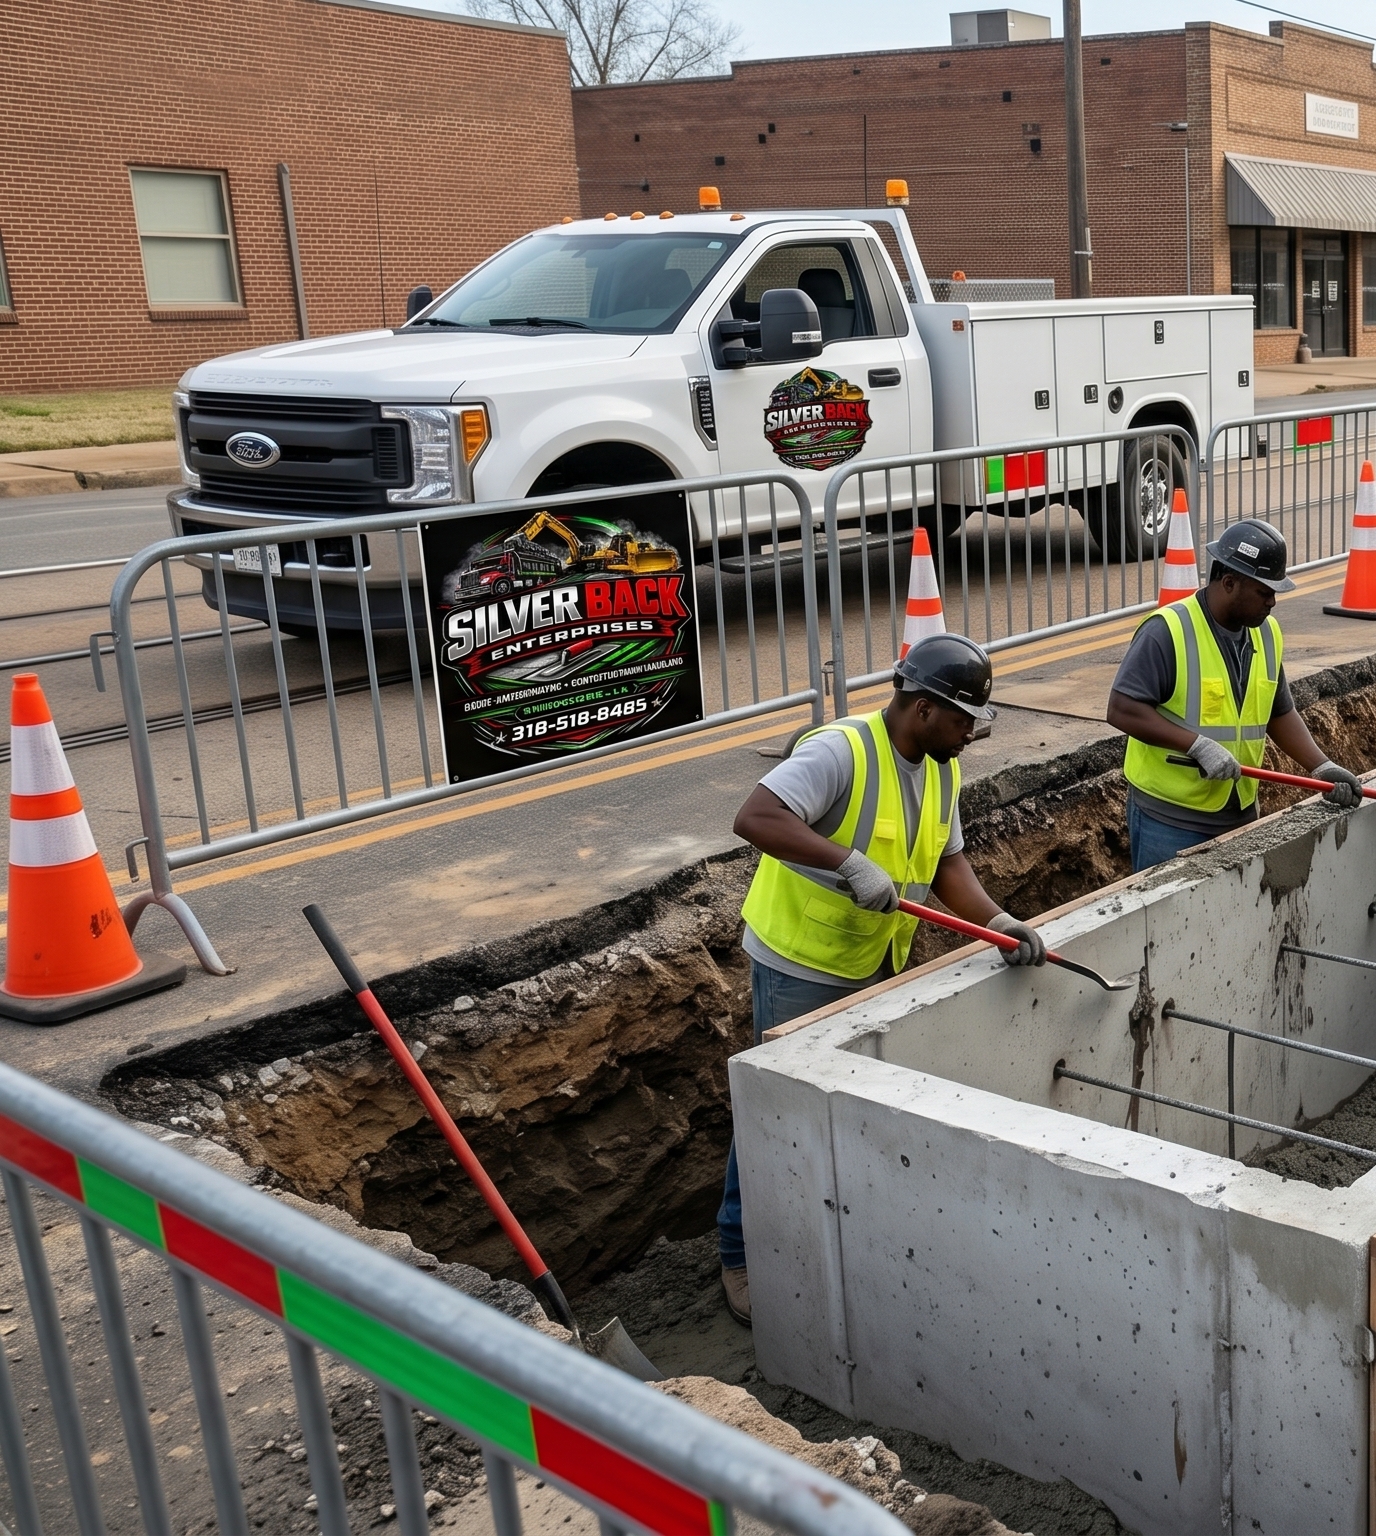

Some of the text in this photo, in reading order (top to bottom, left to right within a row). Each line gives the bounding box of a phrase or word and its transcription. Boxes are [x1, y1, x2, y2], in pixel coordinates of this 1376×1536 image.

[448, 577, 687, 661] SILVER BACK
[491, 620, 653, 661] ENTERPRISES
[511, 698, 648, 742] 318-518-8485
